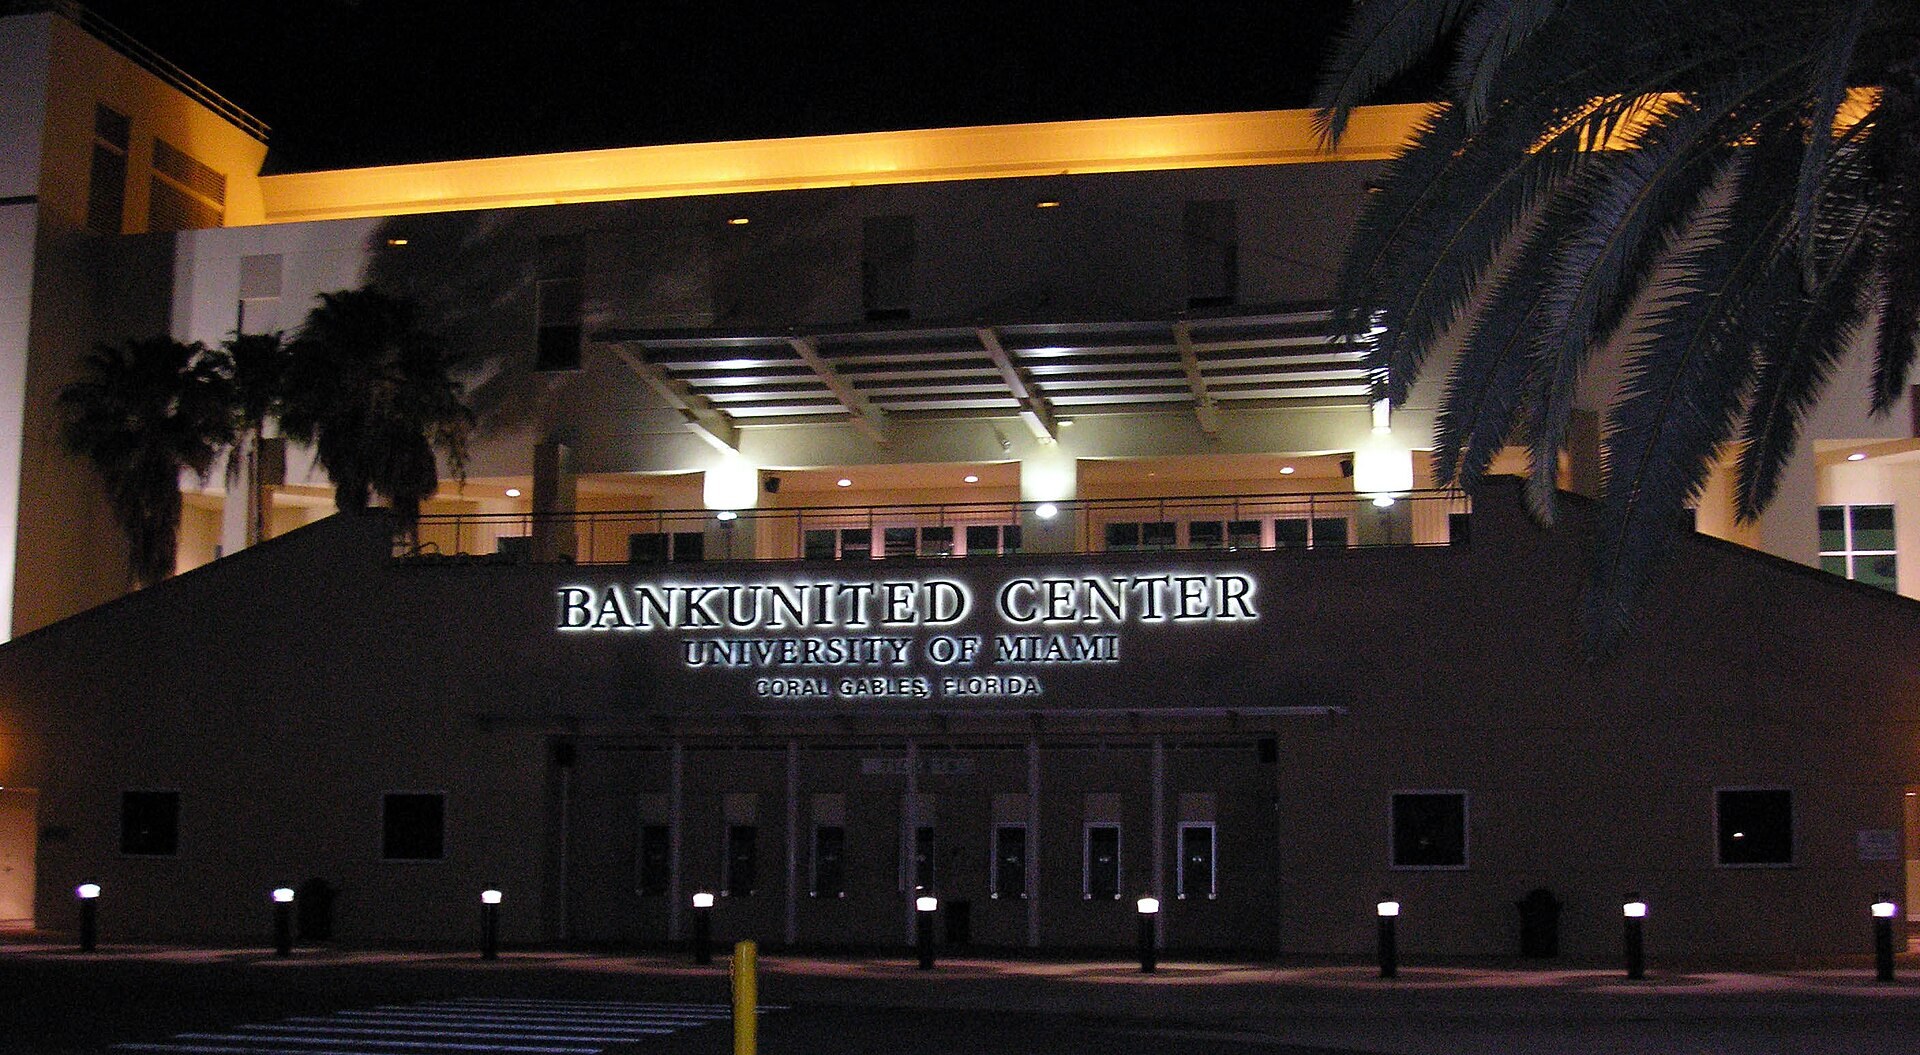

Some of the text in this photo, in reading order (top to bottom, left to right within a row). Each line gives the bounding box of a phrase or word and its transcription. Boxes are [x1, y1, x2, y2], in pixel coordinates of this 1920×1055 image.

[556, 574, 1257, 630] BANKUNITED CENTER
[683, 634, 1120, 666] UNIVERSITY OF MIAMI
[756, 677, 1041, 700] CORAL GABLES, FLORIDA
